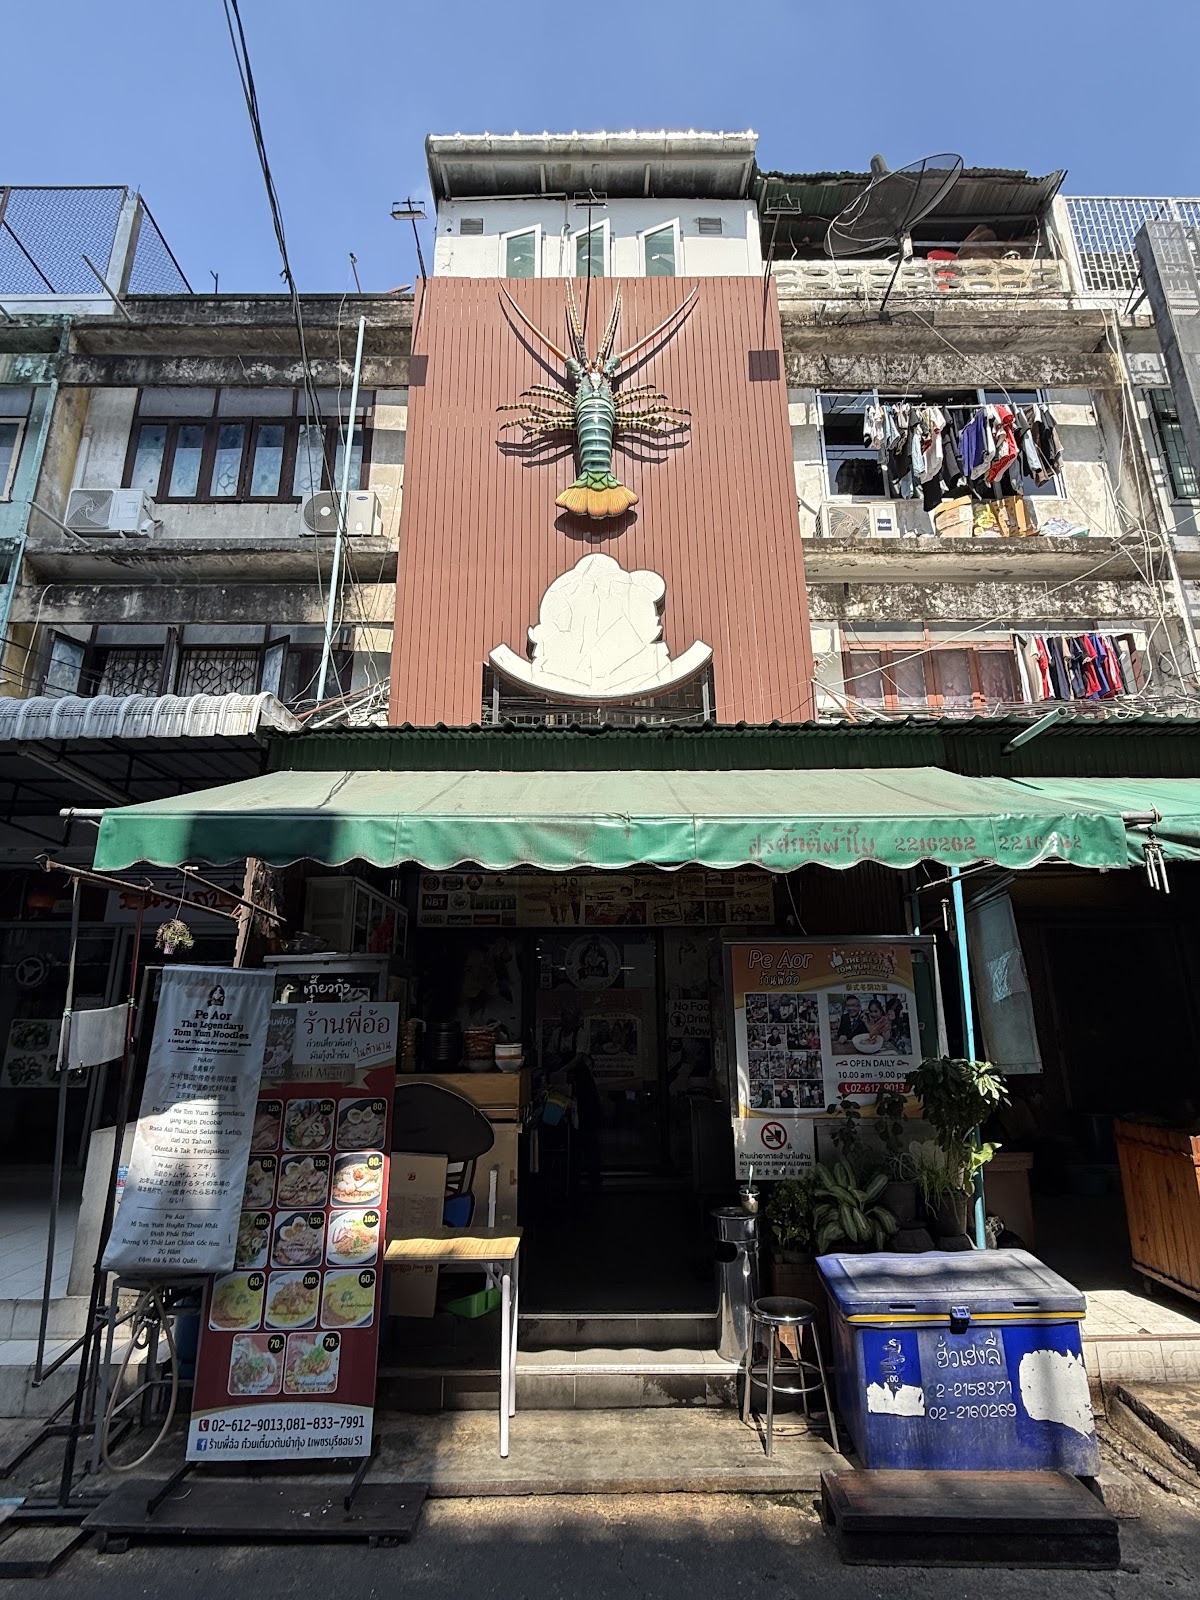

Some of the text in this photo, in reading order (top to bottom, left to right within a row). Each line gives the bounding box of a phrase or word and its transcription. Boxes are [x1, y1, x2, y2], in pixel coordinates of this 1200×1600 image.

[425, 897, 445, 906] NBT
[748, 948, 814, 969] Pe Aor
[837, 965, 852, 974] TOM
[873, 964, 895, 974] KUNG
[674, 1002, 710, 1011] No Foo
[195, 1010, 232, 1021] Pe Aor
[303, 1005, 390, 1034] ร้านพี่อ้อ
[200, 1021, 244, 1032] Legendary
[683, 1026, 711, 1035] Allow
[173, 1028, 192, 1037] Tom
[213, 1031, 249, 1039] Noodles
[368, 1157, 382, 1166] 80.-
[363, 1214, 379, 1223] 100.-
[250, 1277, 263, 1286] 60.-
[304, 1276, 319, 1285] 100.-
[360, 1275, 374, 1284] 60.-
[270, 1339, 283, 1348] 70.-
[325, 1338, 339, 1347] 70.-
[929, 1403, 1017, 1421] 02-2160269
[211, 1416, 365, 1432] 02-612-9013,081-833-7991
[209, 1435, 239, 1449] ร้านพี่อ้อ
